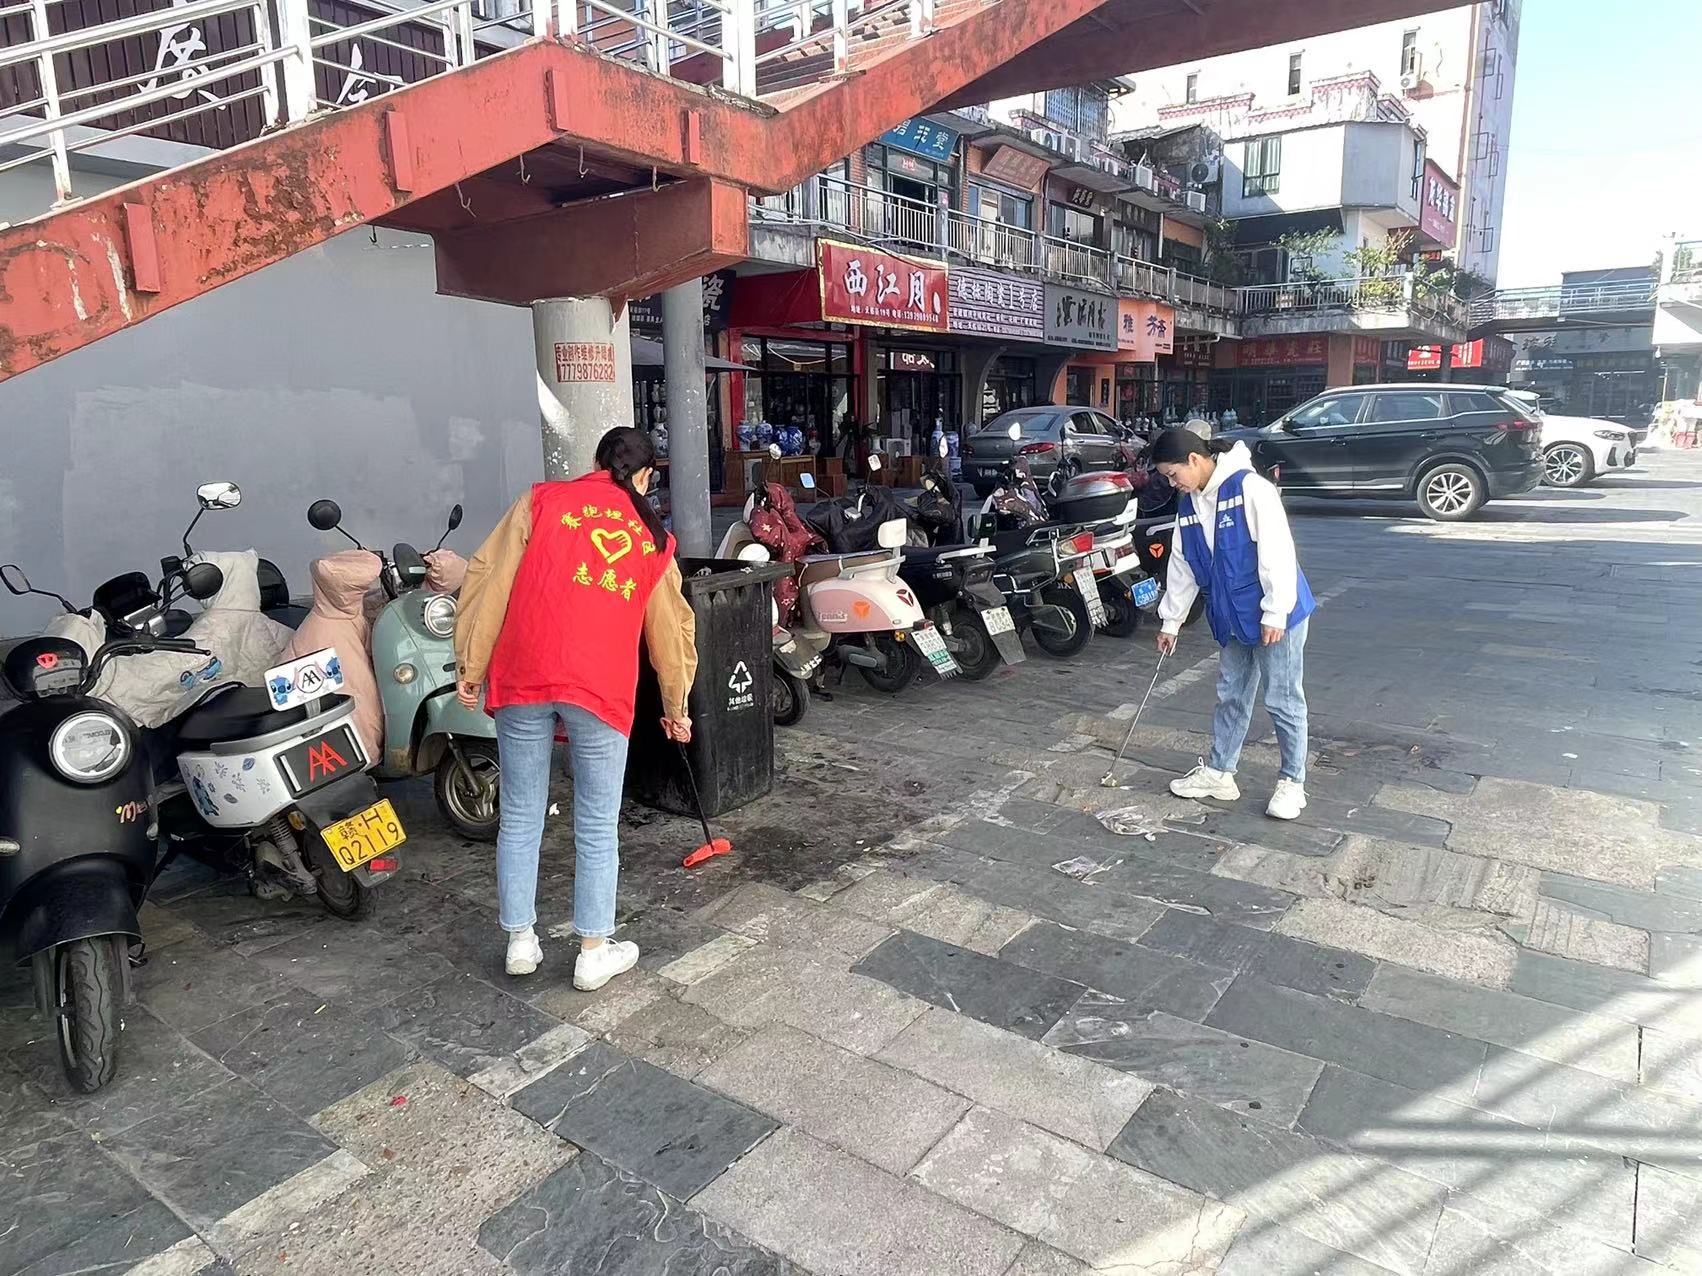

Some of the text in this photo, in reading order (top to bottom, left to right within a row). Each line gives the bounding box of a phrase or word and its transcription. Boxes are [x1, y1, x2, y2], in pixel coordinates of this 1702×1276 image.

[844, 260, 925, 313] 西江月
[573, 562, 637, 601] 志愿者
[338, 821, 400, 865] Q2119
